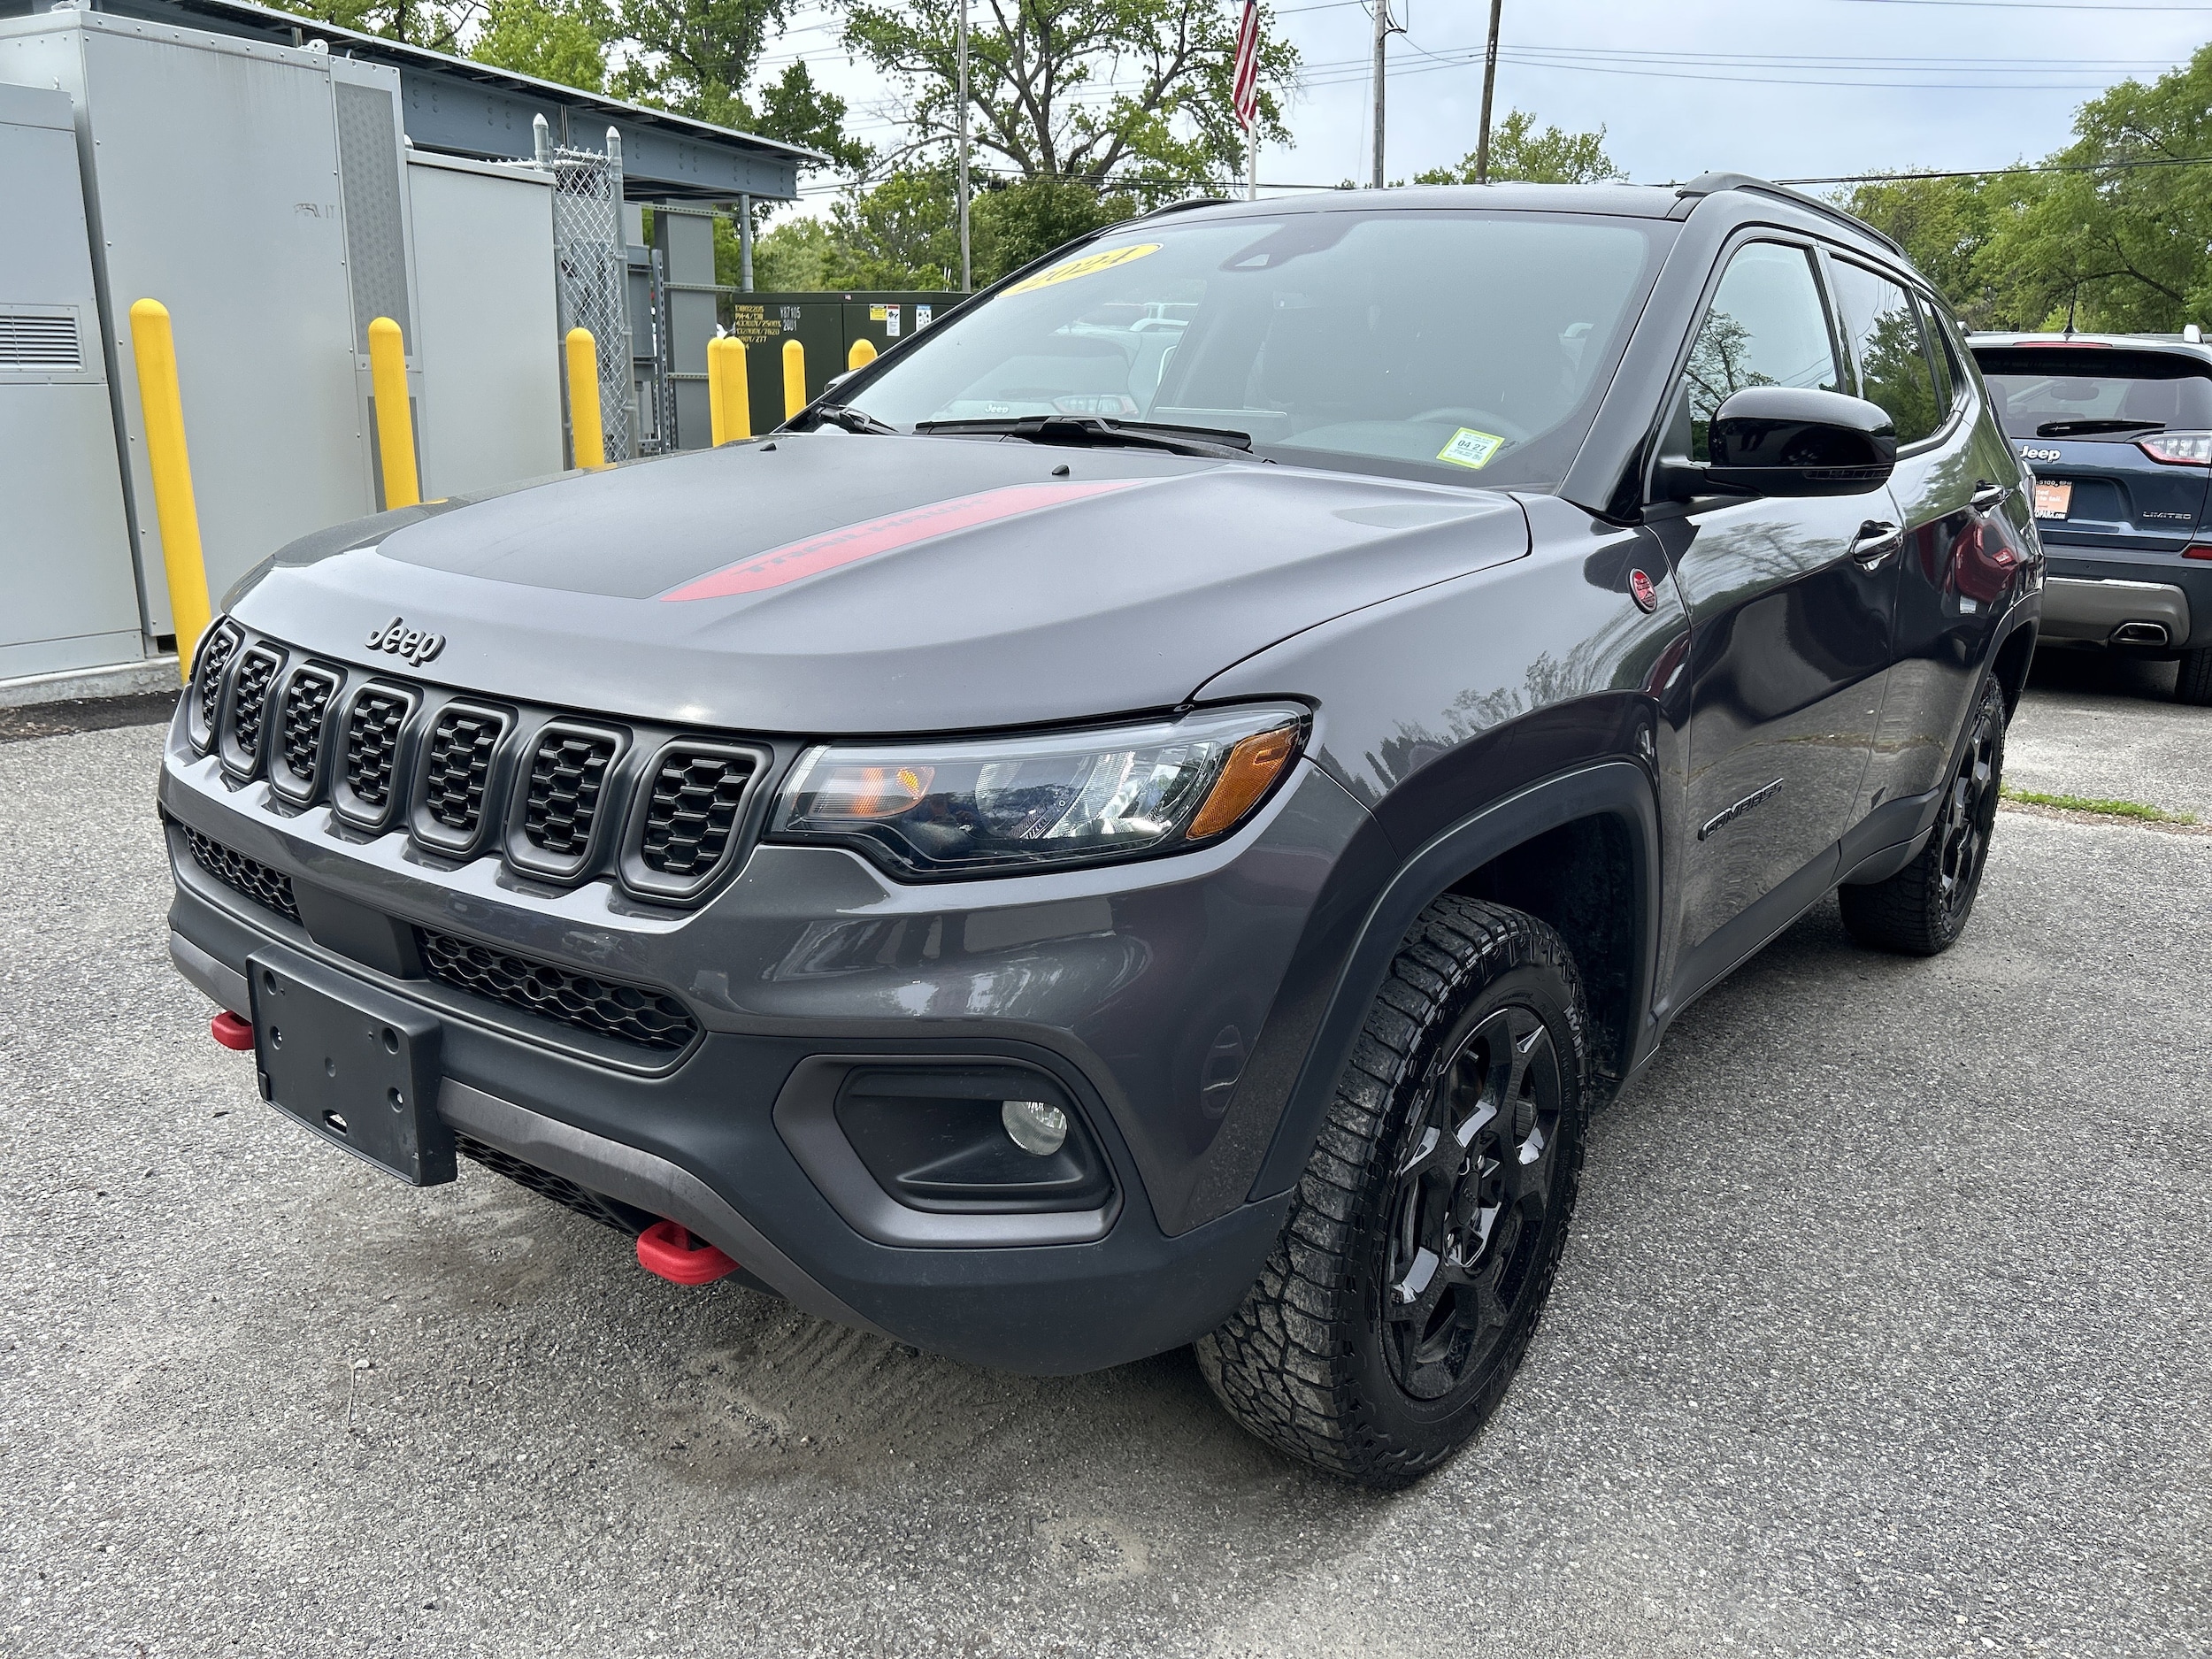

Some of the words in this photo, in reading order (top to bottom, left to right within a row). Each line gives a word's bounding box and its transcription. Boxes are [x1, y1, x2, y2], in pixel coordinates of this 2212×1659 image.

[1018, 247, 1140, 291] 2024
[985, 403, 1010, 414] Jeep
[1457, 440, 1471, 449] 04
[1471, 443, 1487, 452] 27
[2020, 445, 2061, 463] Jeep
[2142, 511, 2192, 520] LIMITED
[733, 497, 991, 574] TRAILHAWK
[365, 616, 447, 668] Jeep
[1697, 777, 1785, 841] COMPASS
